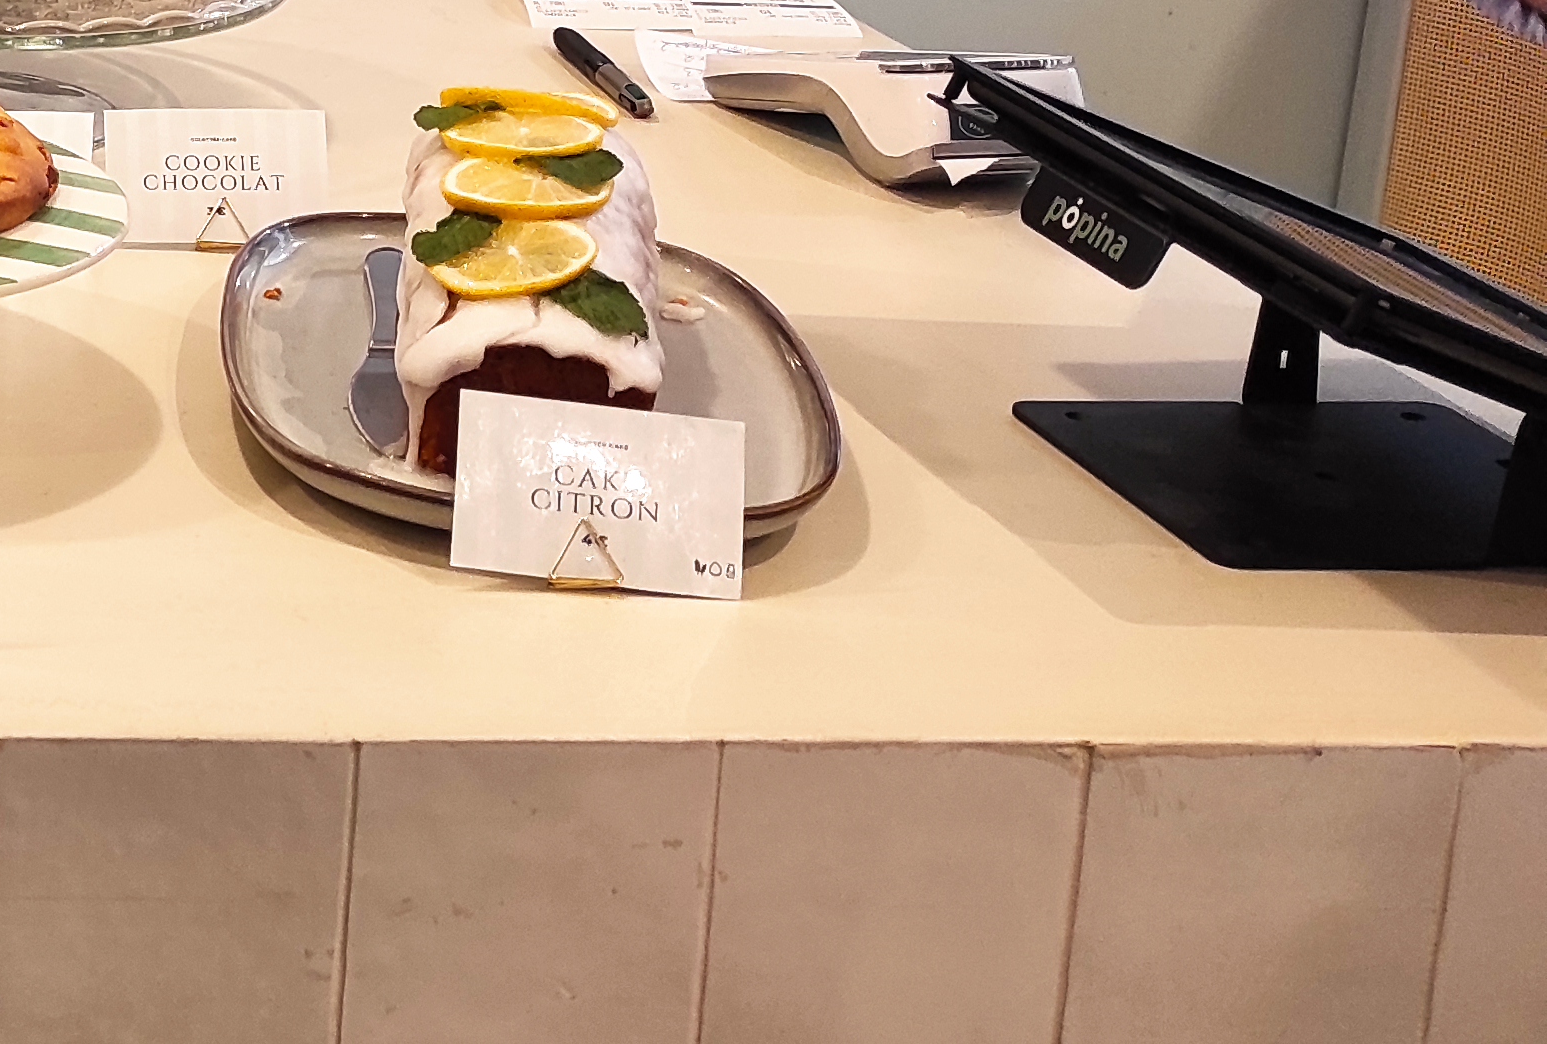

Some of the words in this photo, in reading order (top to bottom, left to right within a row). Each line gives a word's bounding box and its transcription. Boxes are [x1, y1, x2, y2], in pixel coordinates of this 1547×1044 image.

[164, 154, 262, 172] COOKIE
[143, 174, 285, 192] CHOCOLAT
[554, 464, 621, 493] CAK
[530, 487, 660, 523] CITRON
